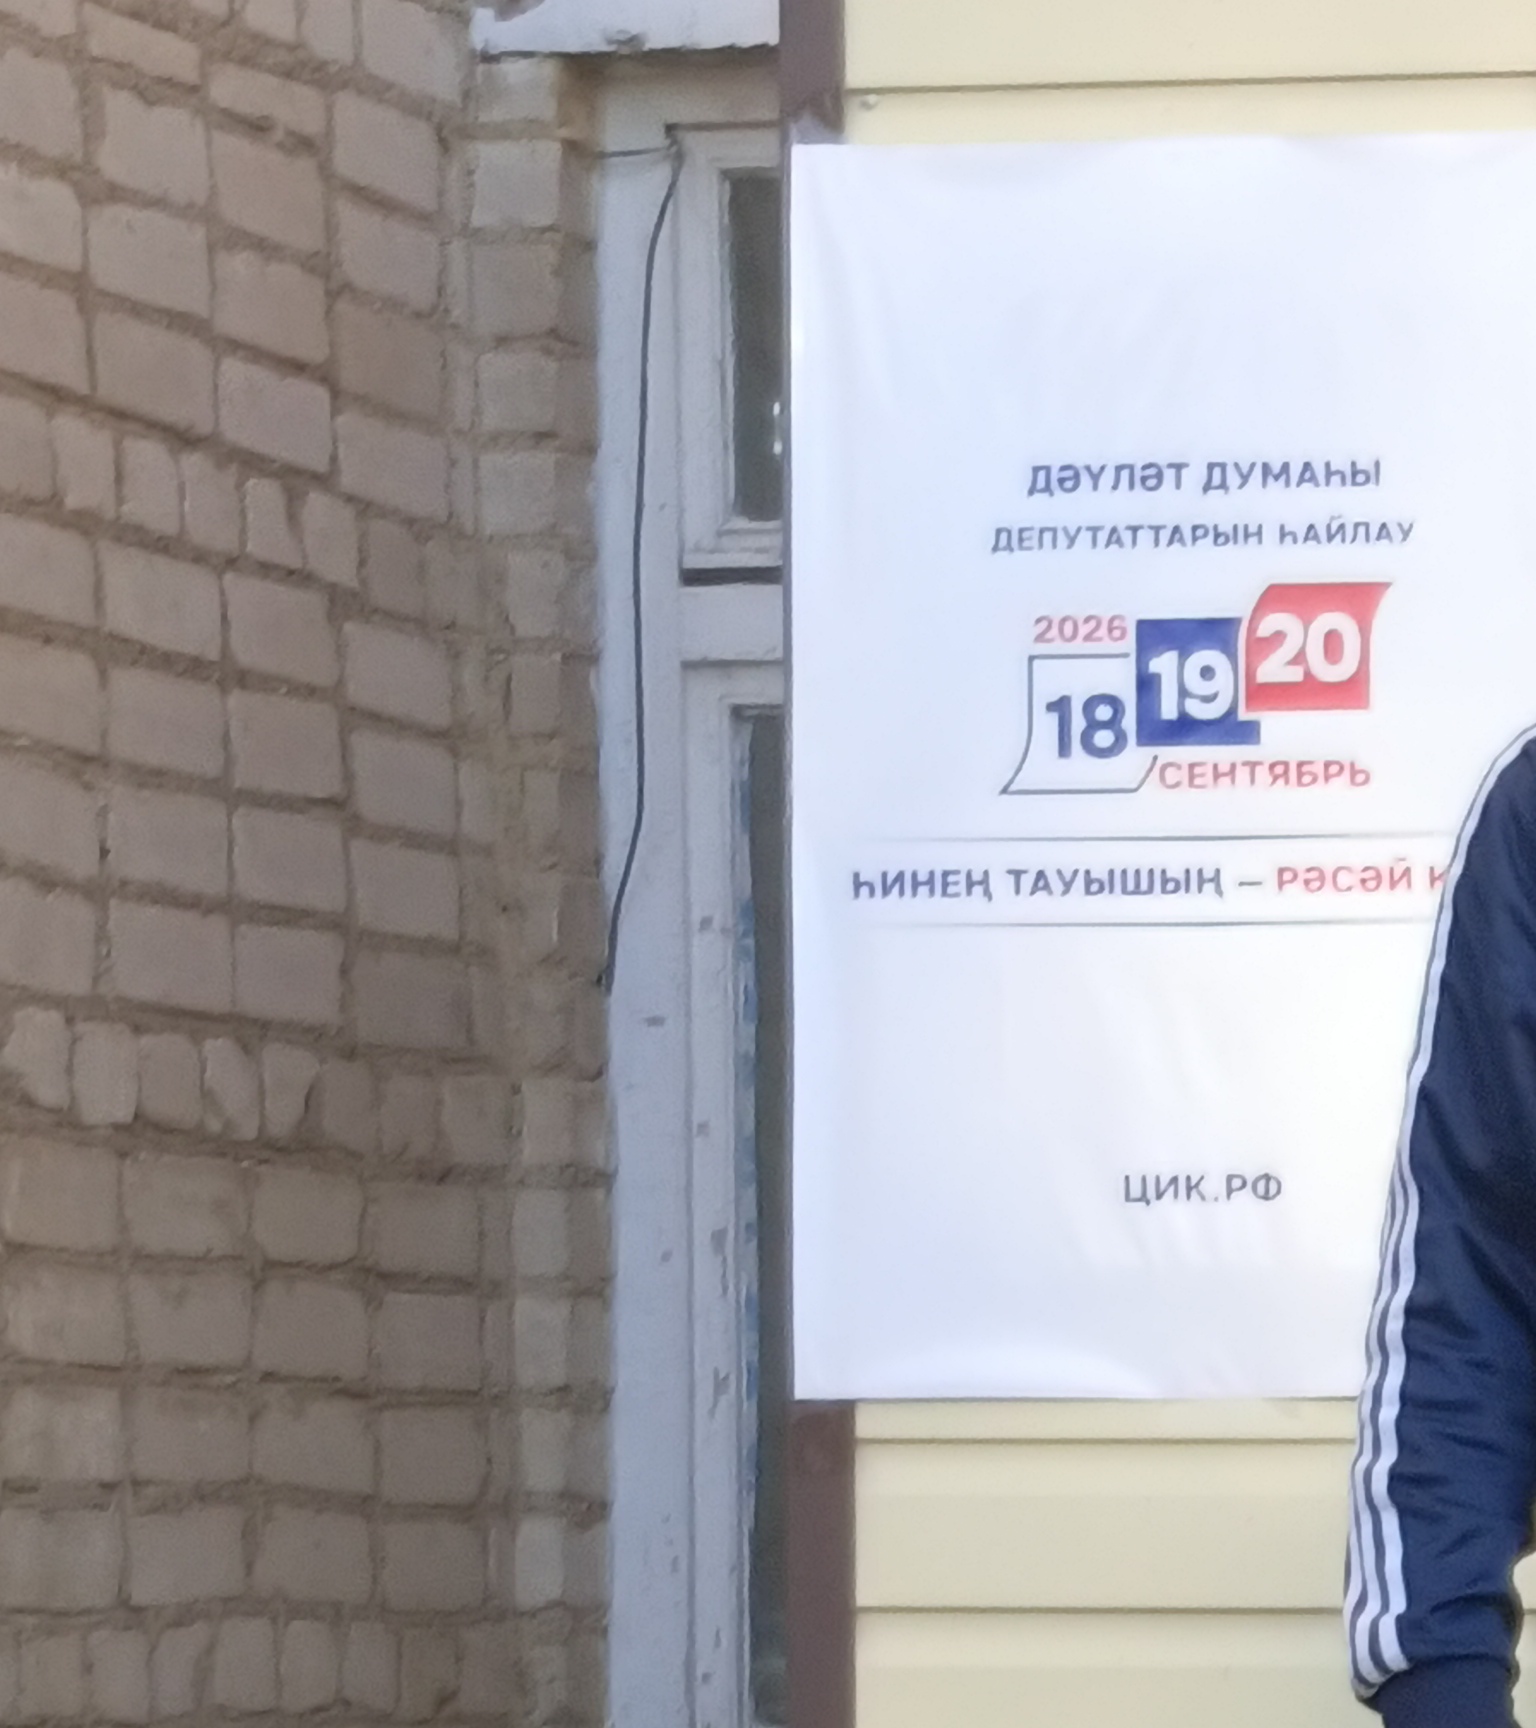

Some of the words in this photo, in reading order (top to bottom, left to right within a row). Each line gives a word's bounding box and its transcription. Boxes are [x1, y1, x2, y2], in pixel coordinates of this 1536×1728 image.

[1027, 462, 1190, 498] ДӘҮЛӘТ
[1202, 459, 1381, 496] ДУМАҺЫ
[991, 523, 1263, 555] ДЕПУТАТТАРЫН
[1279, 515, 1414, 546] ҺАЙЛАУ
[1034, 614, 1128, 644] 2026
[1046, 693, 1128, 759] 18
[1149, 649, 1235, 720] 19
[1255, 610, 1362, 684] 20
[1158, 761, 1371, 790] СЕНТЯБРЬ
[852, 868, 993, 903] ҺИНЕҢ
[1006, 867, 1224, 898] ТАУЫШЫҢ
[1276, 858, 1413, 894] РӘСӘЙ
[1124, 1172, 1283, 1207] ЦИК.РФ
